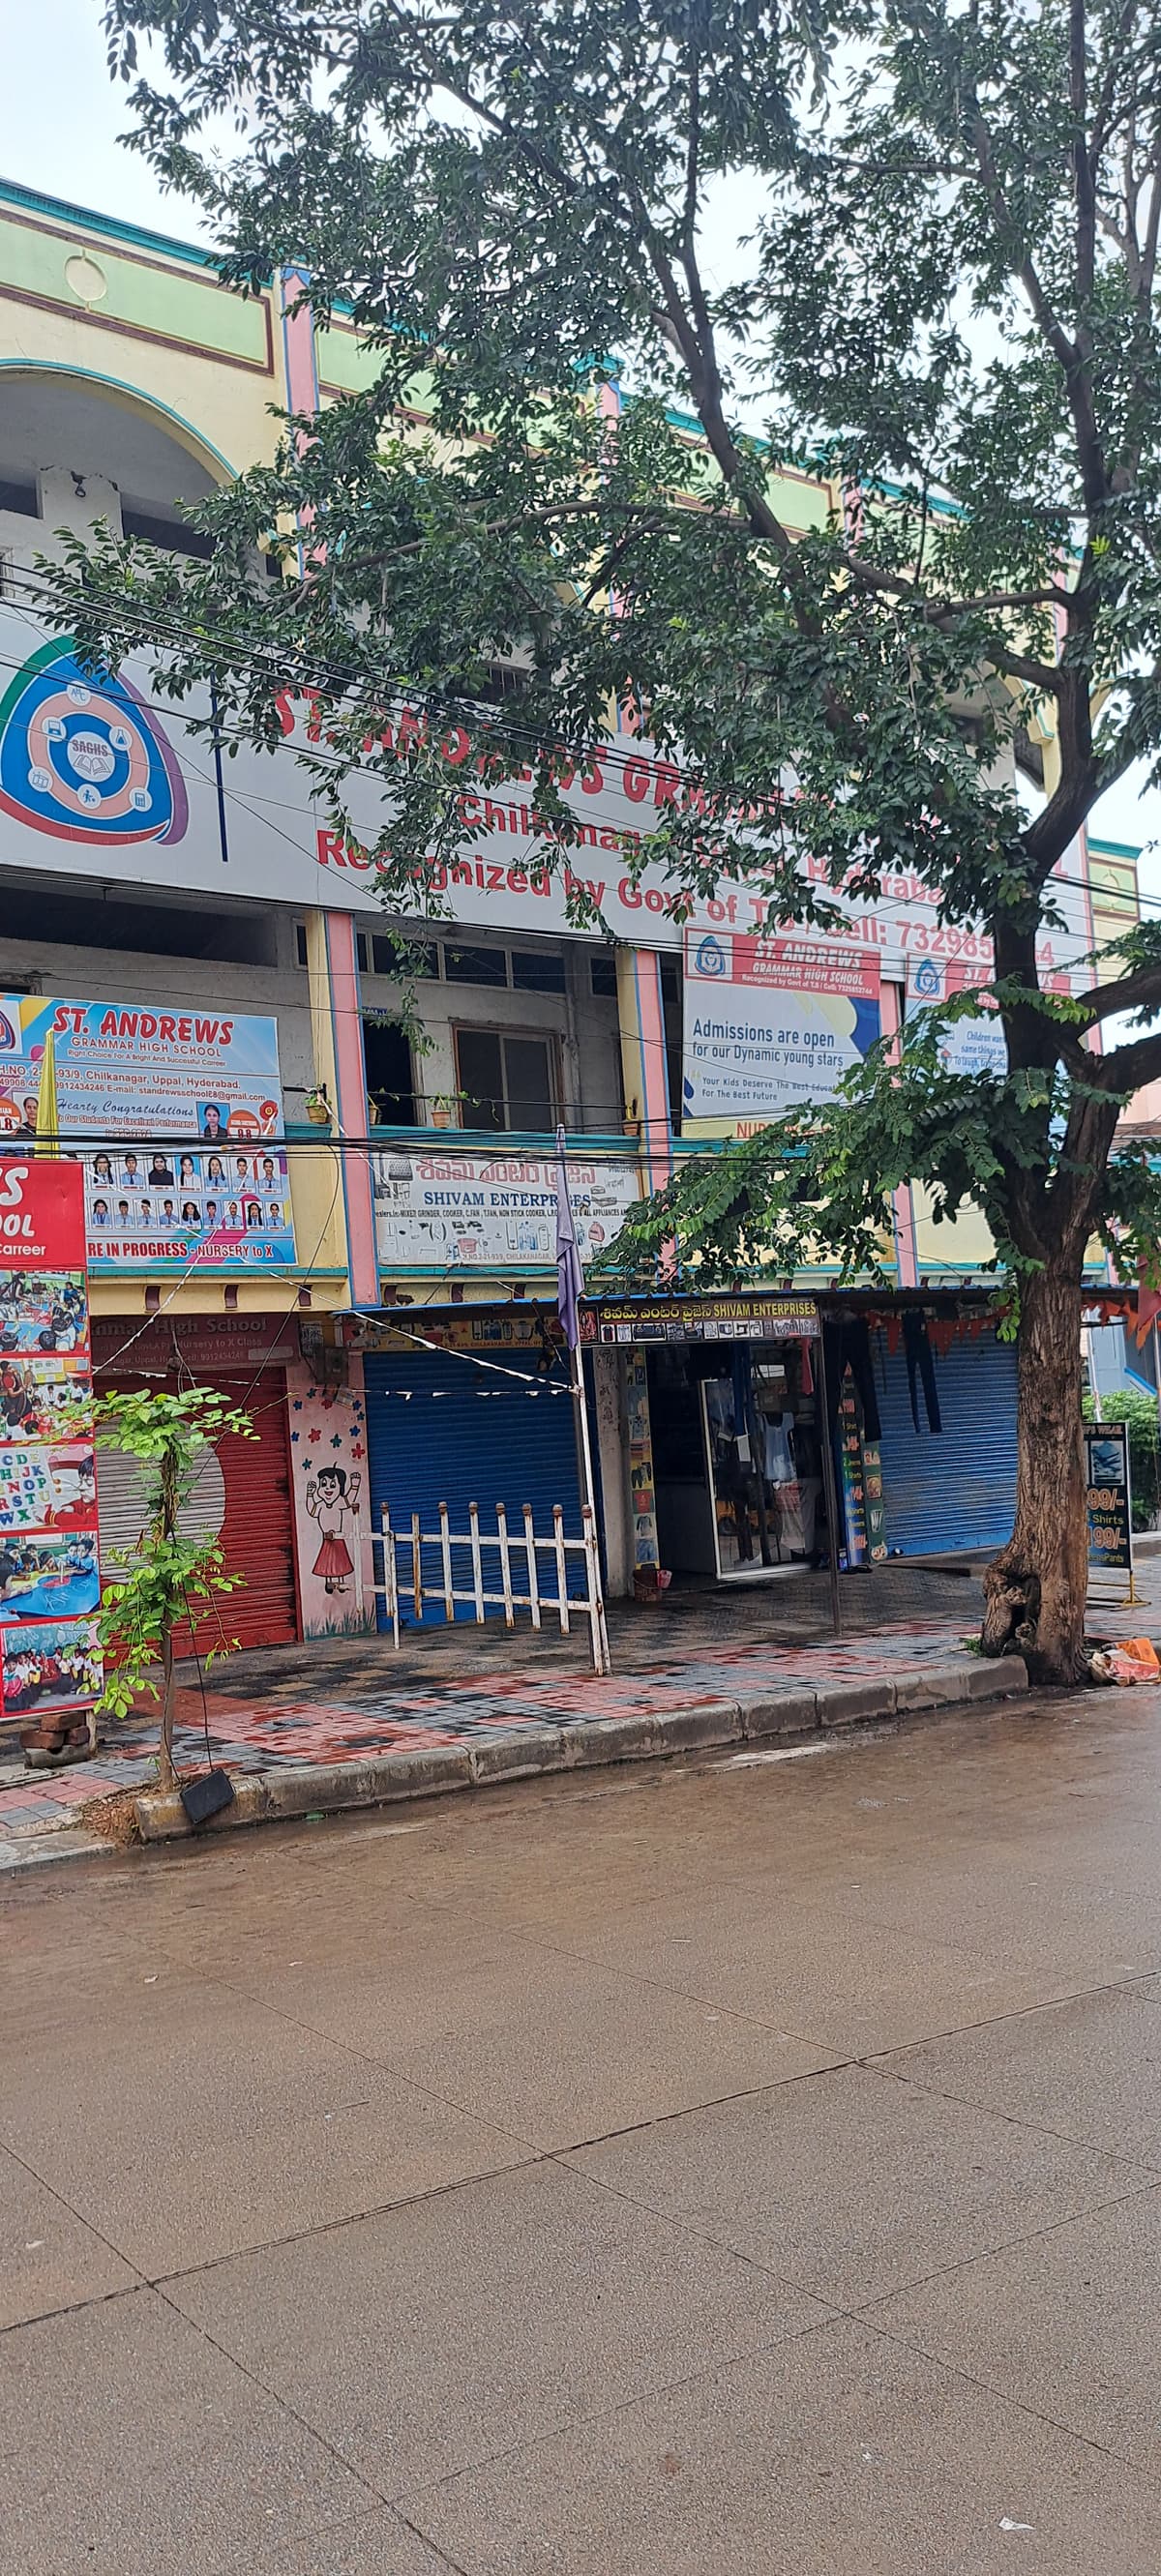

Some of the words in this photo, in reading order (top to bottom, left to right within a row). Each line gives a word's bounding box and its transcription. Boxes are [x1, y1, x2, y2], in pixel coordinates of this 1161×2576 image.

[72, 739, 108, 757] SAGHS
[706, 893, 738, 925] of
[895, 920, 1055, 966] 7329854
[755, 941, 777, 960] ST.
[780, 942, 863, 968] ANDREWS
[752, 962, 802, 980] GRAMMAR
[804, 967, 827, 981] HIGH
[830, 970, 863, 986] SCHOOL
[52, 1007, 89, 1034] ST.
[100, 1011, 234, 1046] ANDREWS
[693, 1019, 773, 1042] Admissions
[777, 1029, 799, 1045] are
[803, 1032, 835, 1052] open
[71, 1037, 134, 1051] GRAMMAR
[139, 1042, 169, 1053] HIGH
[173, 1045, 222, 1057] SCHOOL
[693, 1042, 711, 1057] for
[712, 1047, 730, 1059] our
[734, 1045, 781, 1063] Dynamic
[784, 1052, 815, 1068] young
[817, 1053, 844, 1067] stars
[68, 1050, 86, 1059] Right
[87, 1050, 112, 1059] Choice
[133, 1052, 151, 1063] Bright
[166, 1055, 200, 1065] Successful
[32, 1066, 83, 1081] 2--93/9,
[86, 1070, 149, 1084] Chilkanagar,
[152, 1075, 184, 1086] Uppal,
[187, 1078, 241, 1089] Hyderabad.
[702, 1077, 720, 1086] Your
[723, 1078, 739, 1087] Kids
[742, 1079, 773, 1089] Deserve
[106, 1084, 136, 1094] E-mail:
[702, 1089, 716, 1098] For
[717, 1090, 730, 1099] The
[732, 1091, 751, 1100] Best
[753, 1091, 778, 1101] Future
[56, 1098, 99, 1115] Hearty
[103, 1100, 194, 1116] Congratulations
[0, 1166, 29, 1206] S
[424, 1191, 485, 1206] SHIVAM
[490, 1193, 592, 1208] ENTERPRES
[0, 1213, 35, 1237] OL
[88, 1242, 104, 1257] RE
[106, 1242, 119, 1257] IN
[123, 1242, 188, 1257] PROGRESS
[197, 1244, 250, 1257] NURSERY
[253, 1247, 262, 1257] to
[265, 1247, 273, 1257] X
[713, 1303, 751, 1317] SHIVAM
[753, 1302, 817, 1317] ENTERPRISES
[206, 1318, 268, 1333] School
[216, 1339, 225, 1347] to
[1087, 1488, 1125, 1511] 99/-
[1092, 1514, 1124, 1525] Shirts
